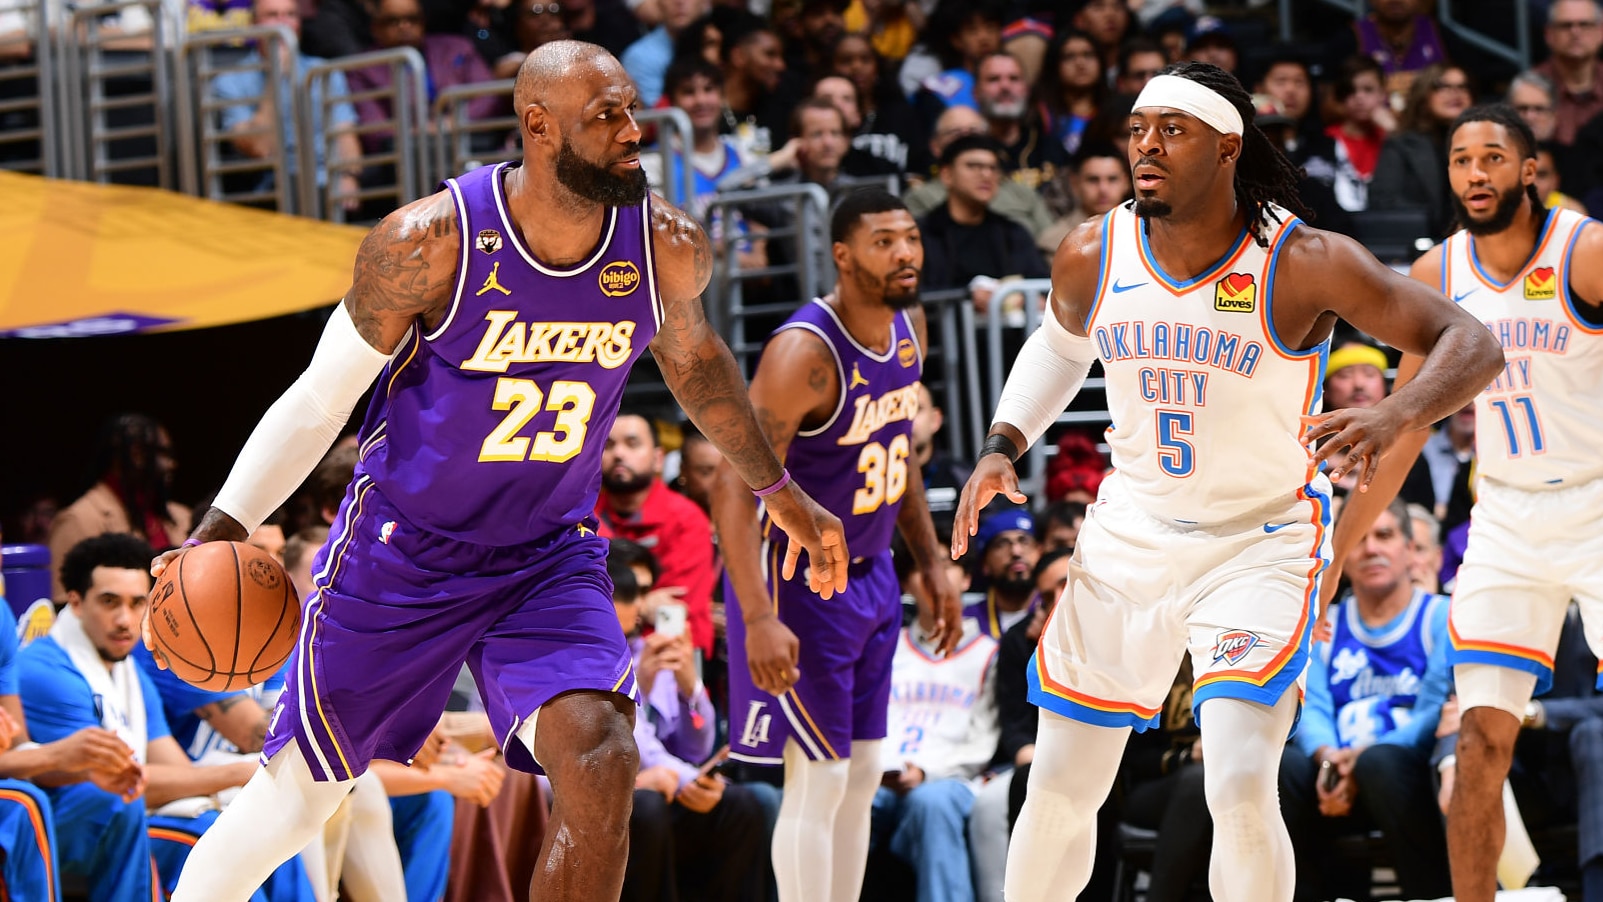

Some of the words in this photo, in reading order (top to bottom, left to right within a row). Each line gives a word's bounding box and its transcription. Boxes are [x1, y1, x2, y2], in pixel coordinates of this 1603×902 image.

[603, 270, 637, 286] bibigo
[459, 310, 637, 373] LAKERS
[1095, 321, 1263, 379] OKLAHOMA
[1485, 317, 1573, 355] HOMA
[1138, 367, 1209, 407] CITY
[478, 377, 597, 463] 23
[1155, 409, 1196, 478] 5
[1487, 394, 1547, 459] 11
[852, 433, 910, 515] 36
